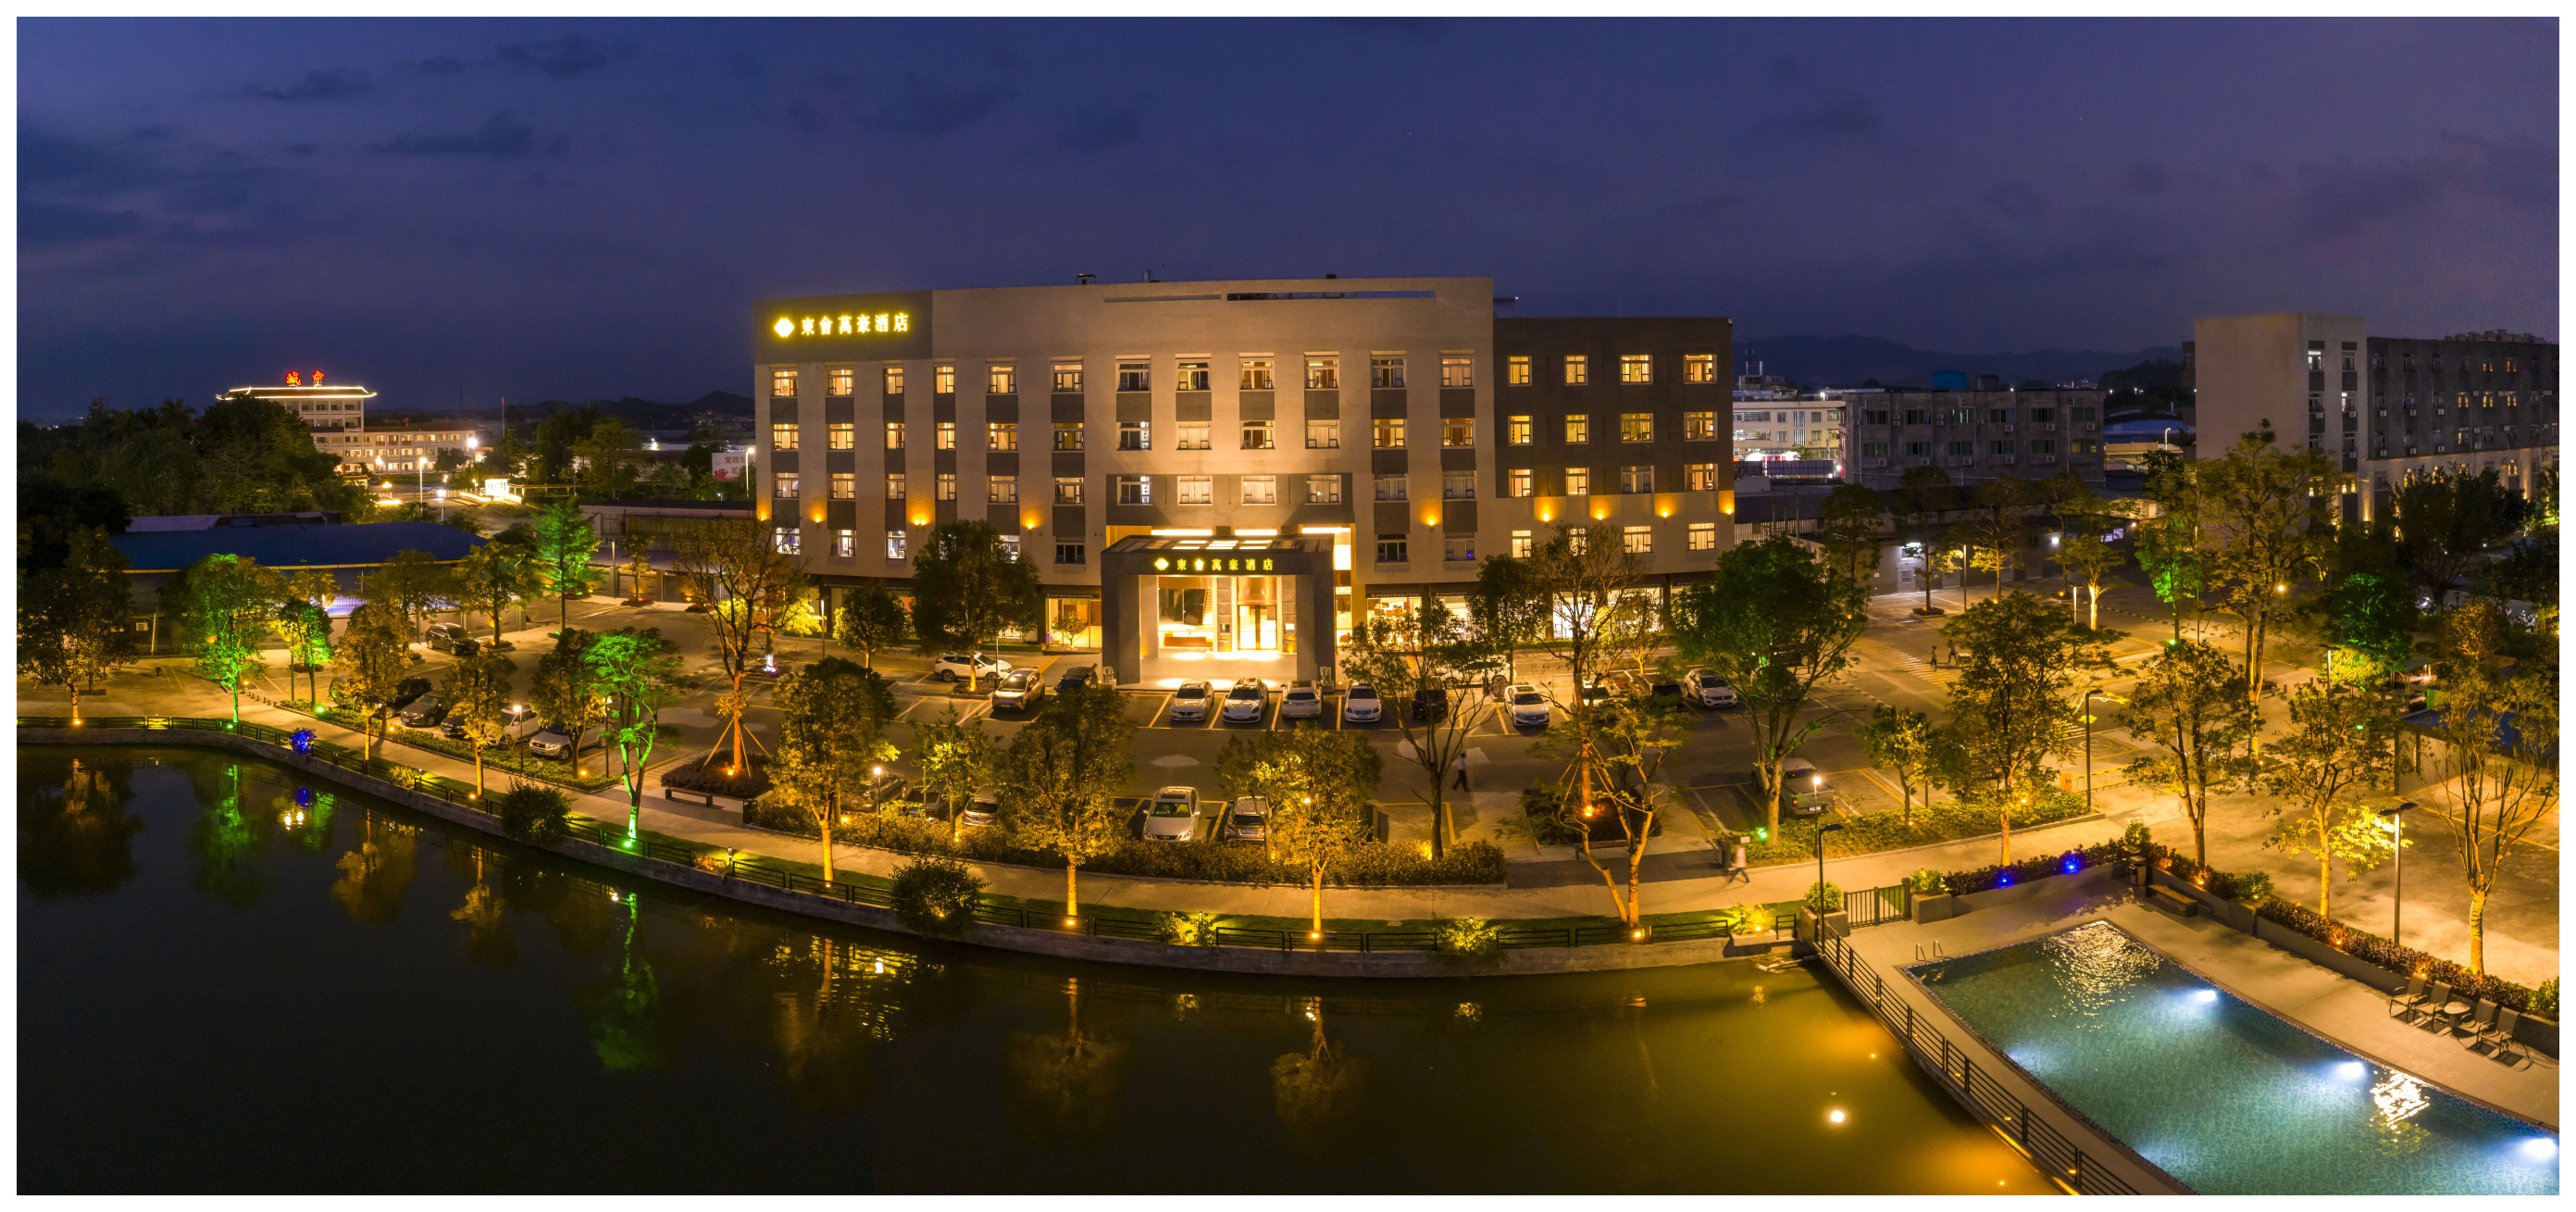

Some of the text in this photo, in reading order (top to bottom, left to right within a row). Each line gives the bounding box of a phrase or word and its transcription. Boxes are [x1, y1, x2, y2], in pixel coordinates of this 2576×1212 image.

[801, 312, 909, 336] 東會萬豪酒店
